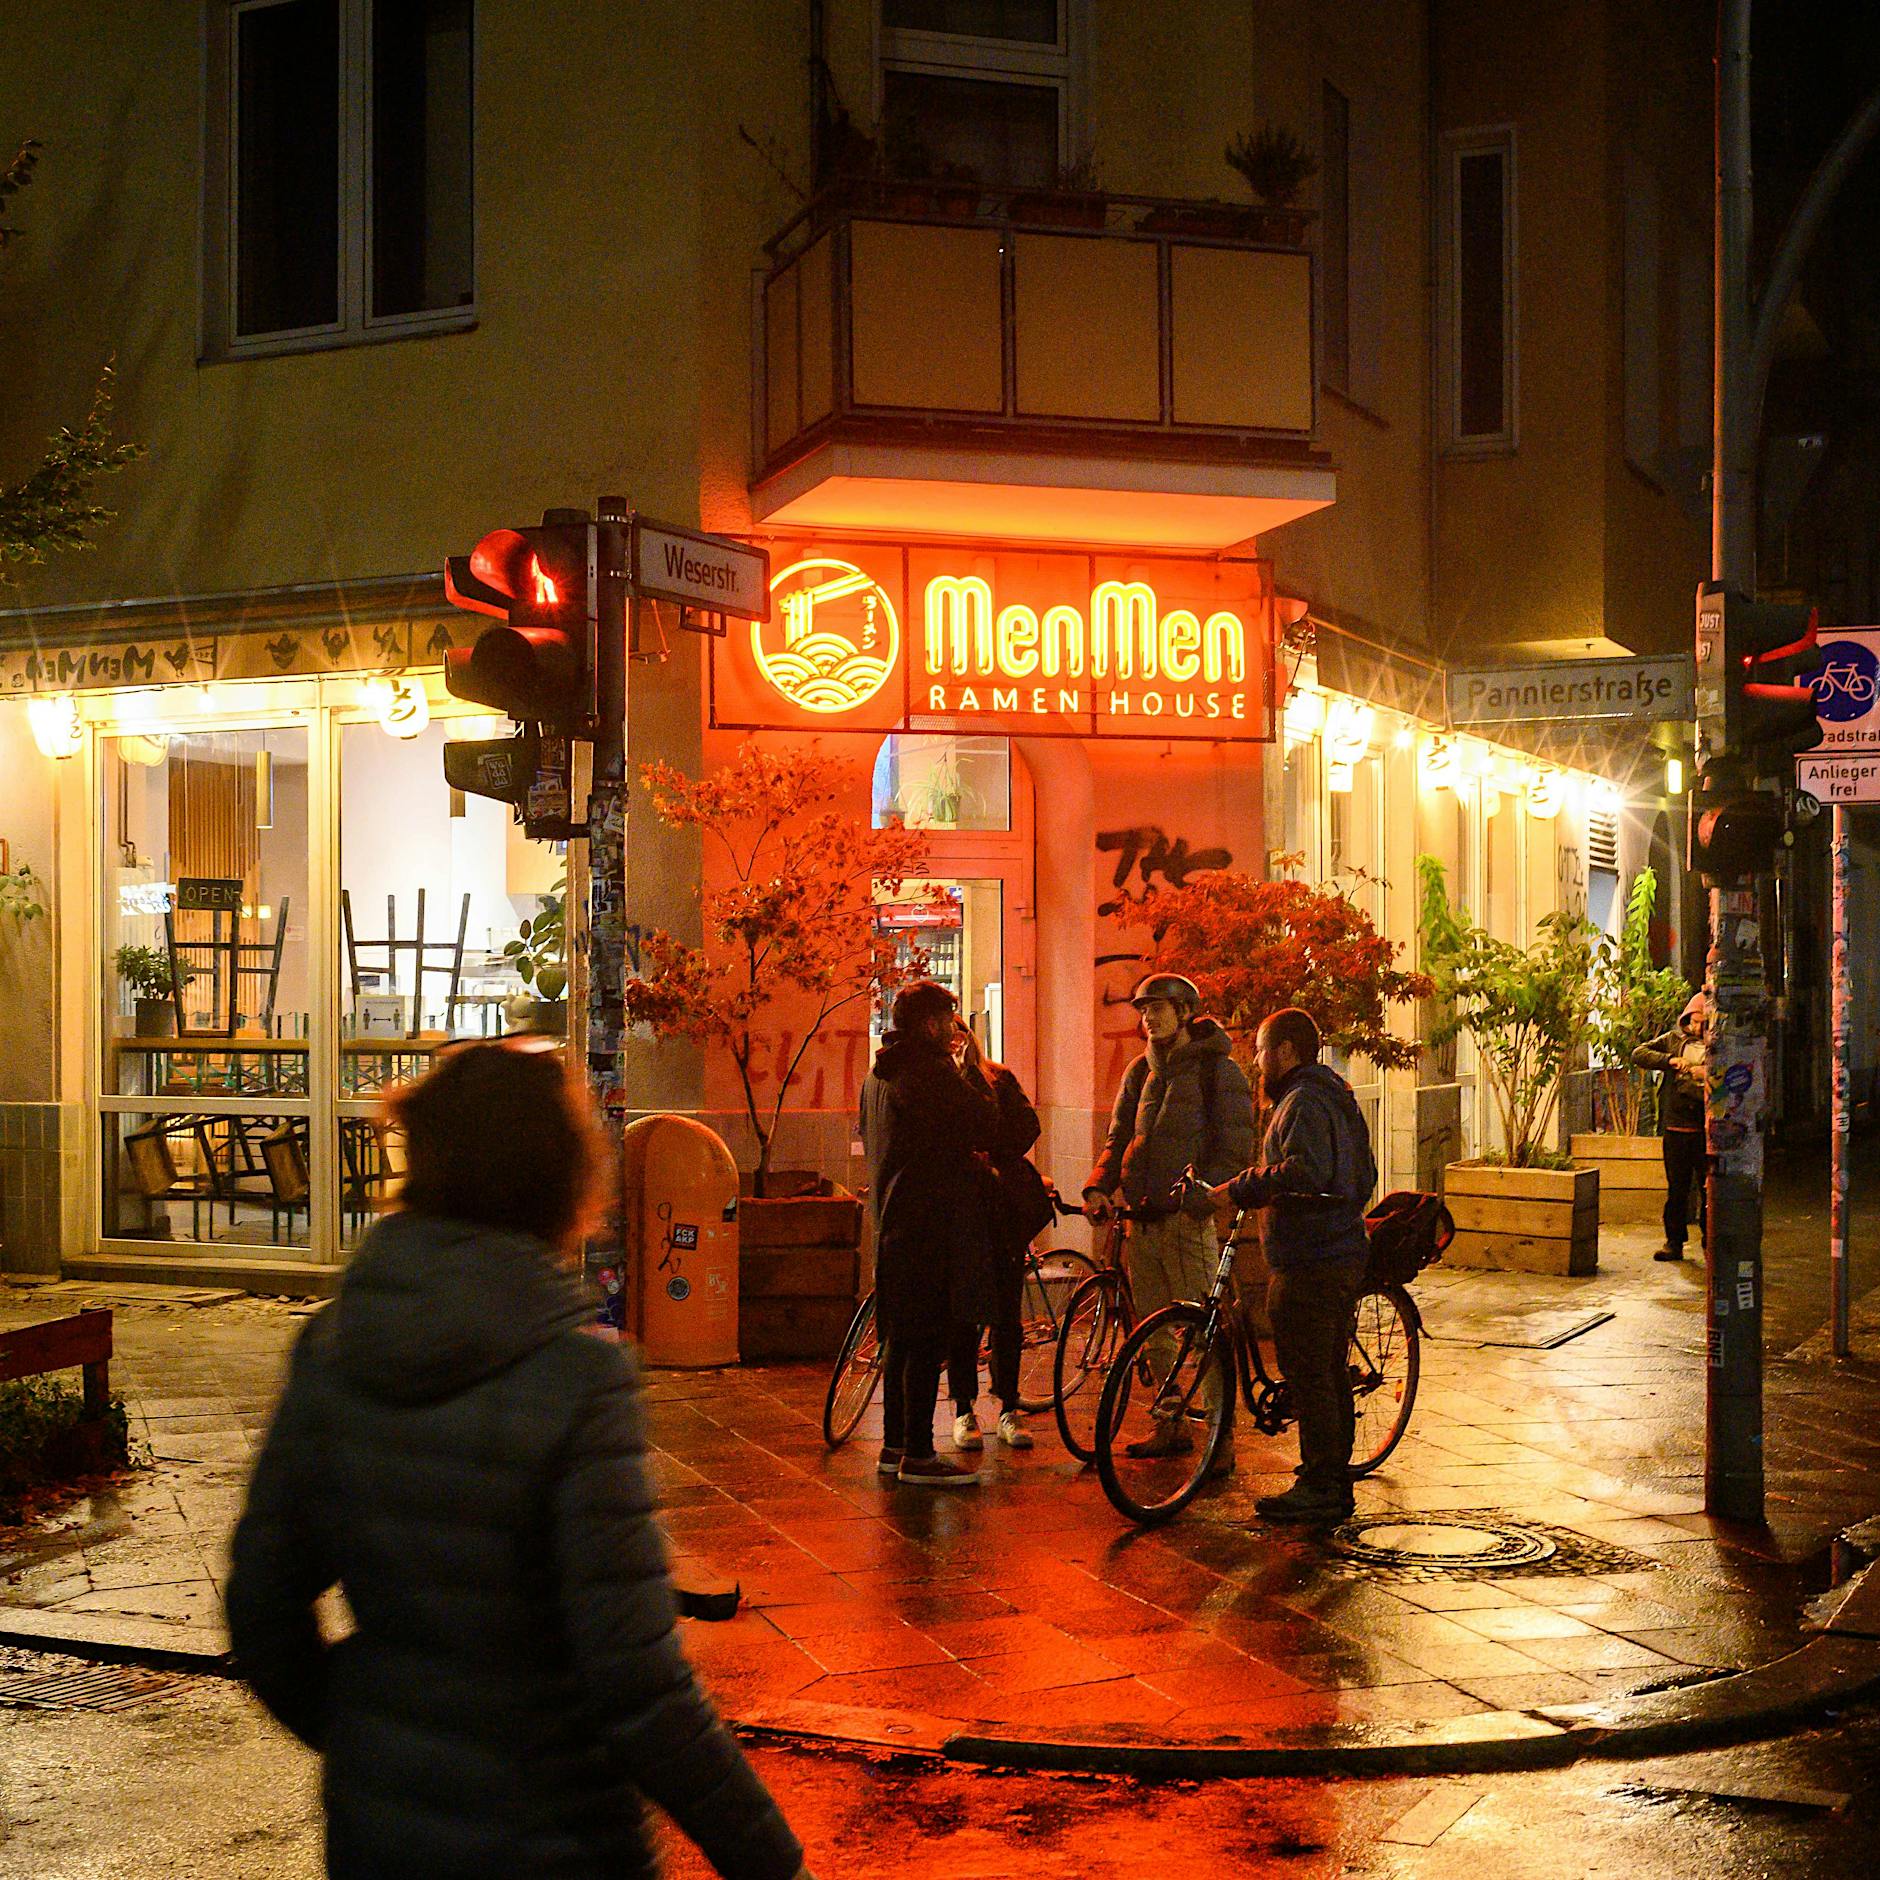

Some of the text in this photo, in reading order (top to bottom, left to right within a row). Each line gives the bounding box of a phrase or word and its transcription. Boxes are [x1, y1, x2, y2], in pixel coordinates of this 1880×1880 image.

[664, 543, 740, 592] Weserstr.
[924, 575, 1245, 684] MenMen
[1700, 613, 1720, 629] JUST
[1467, 670, 1673, 708] Pannierstraße
[929, 685, 1245, 719] RAMEN HOUSE
[1809, 765, 1878, 781] Anlieger
[1830, 782, 1858, 797] frei
[185, 886, 233, 903] OPEN
[675, 1228, 696, 1237] FCK
